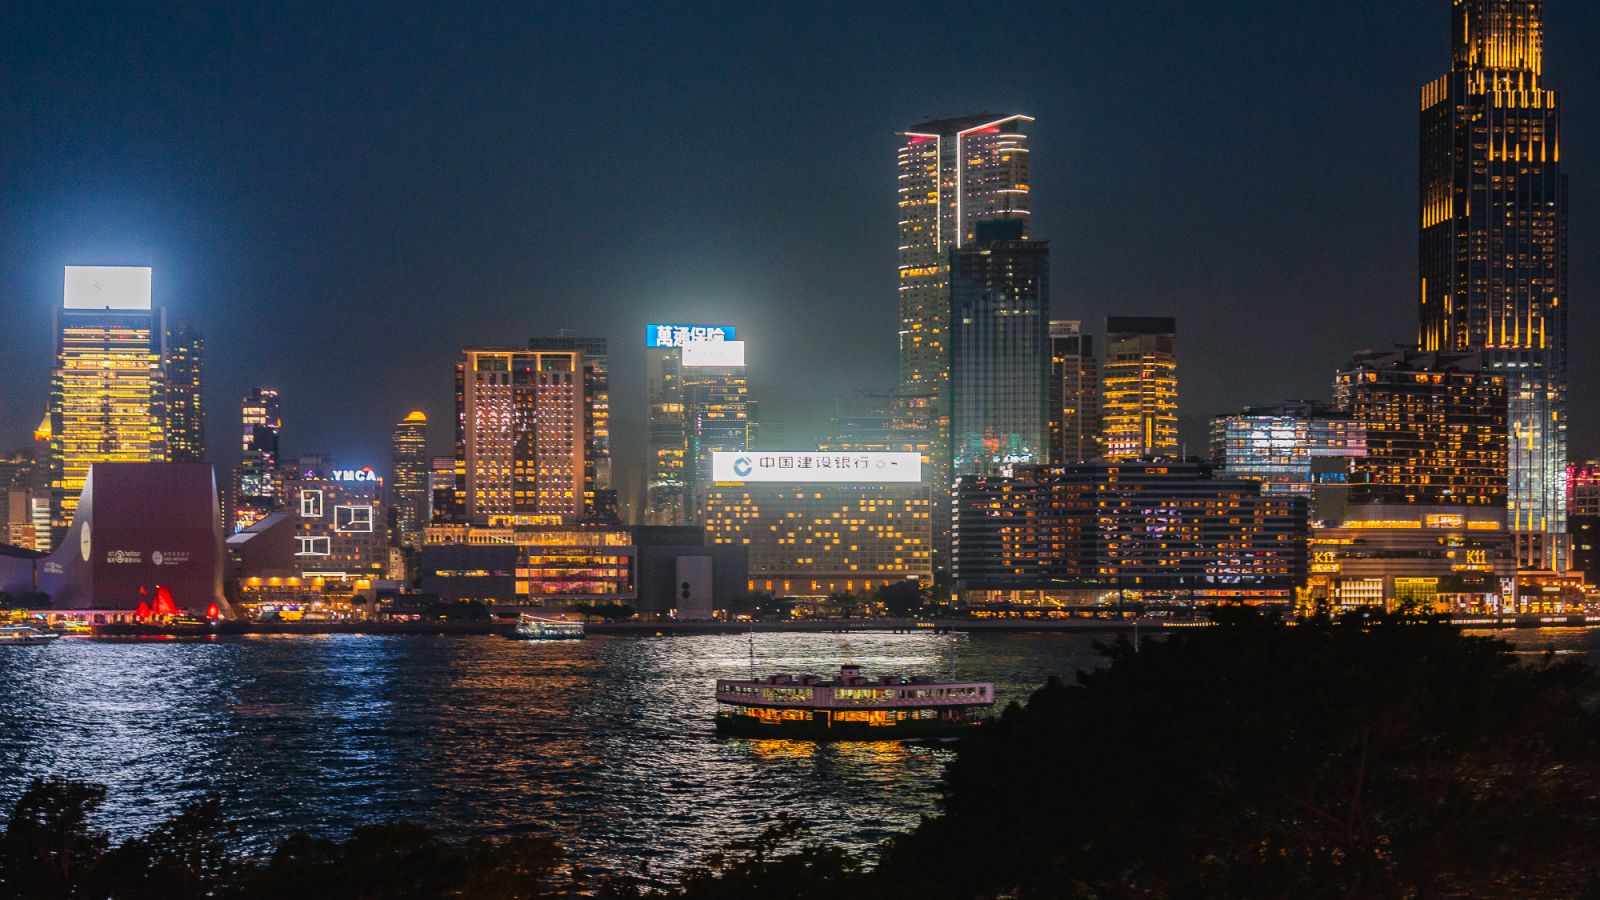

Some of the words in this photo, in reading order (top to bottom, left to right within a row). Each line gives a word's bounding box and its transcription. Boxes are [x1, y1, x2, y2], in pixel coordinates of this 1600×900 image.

[759, 456, 869, 469] 中国建设银行
[332, 470, 377, 481] YMCA
[1313, 551, 1335, 563] K11
[1466, 550, 1487, 564] K11
